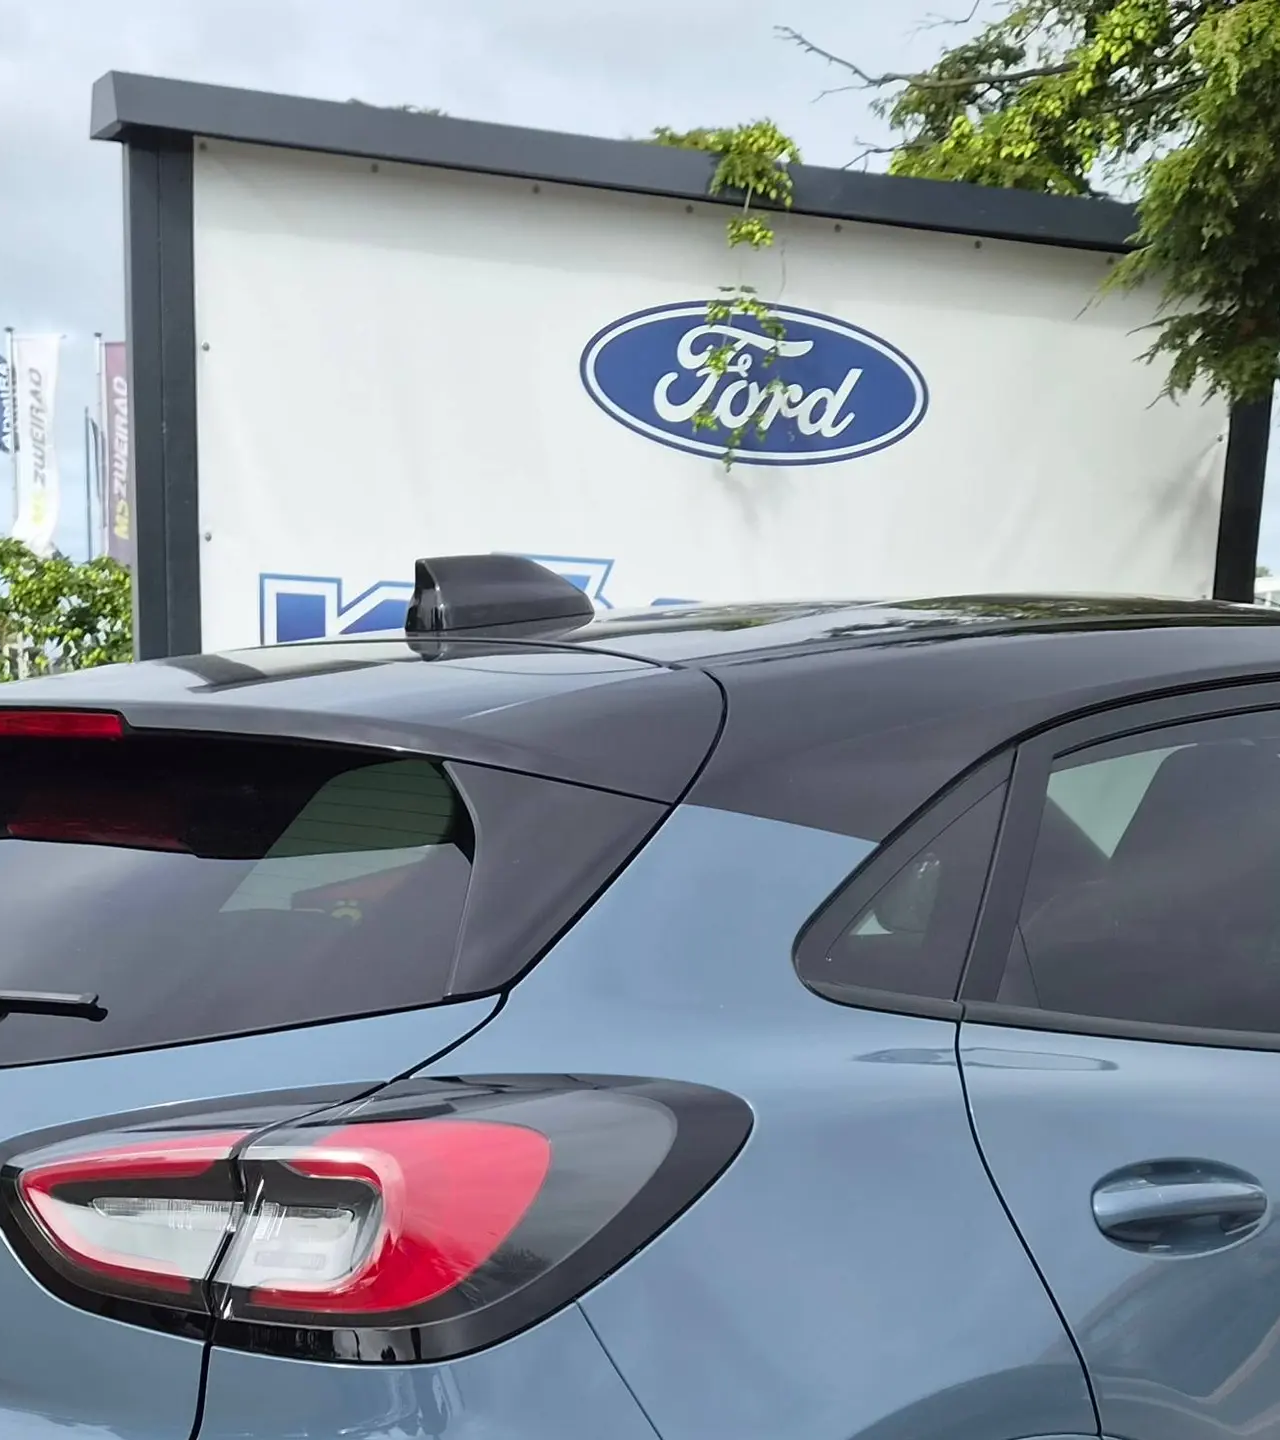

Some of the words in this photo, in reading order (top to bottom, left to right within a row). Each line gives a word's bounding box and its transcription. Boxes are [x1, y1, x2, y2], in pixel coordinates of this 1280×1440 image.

[28, 367, 46, 488] ZWEIRAD
[113, 375, 129, 497] ZWEIRAD
[653, 324, 863, 438] Ford
[113, 498, 130, 541] MS
